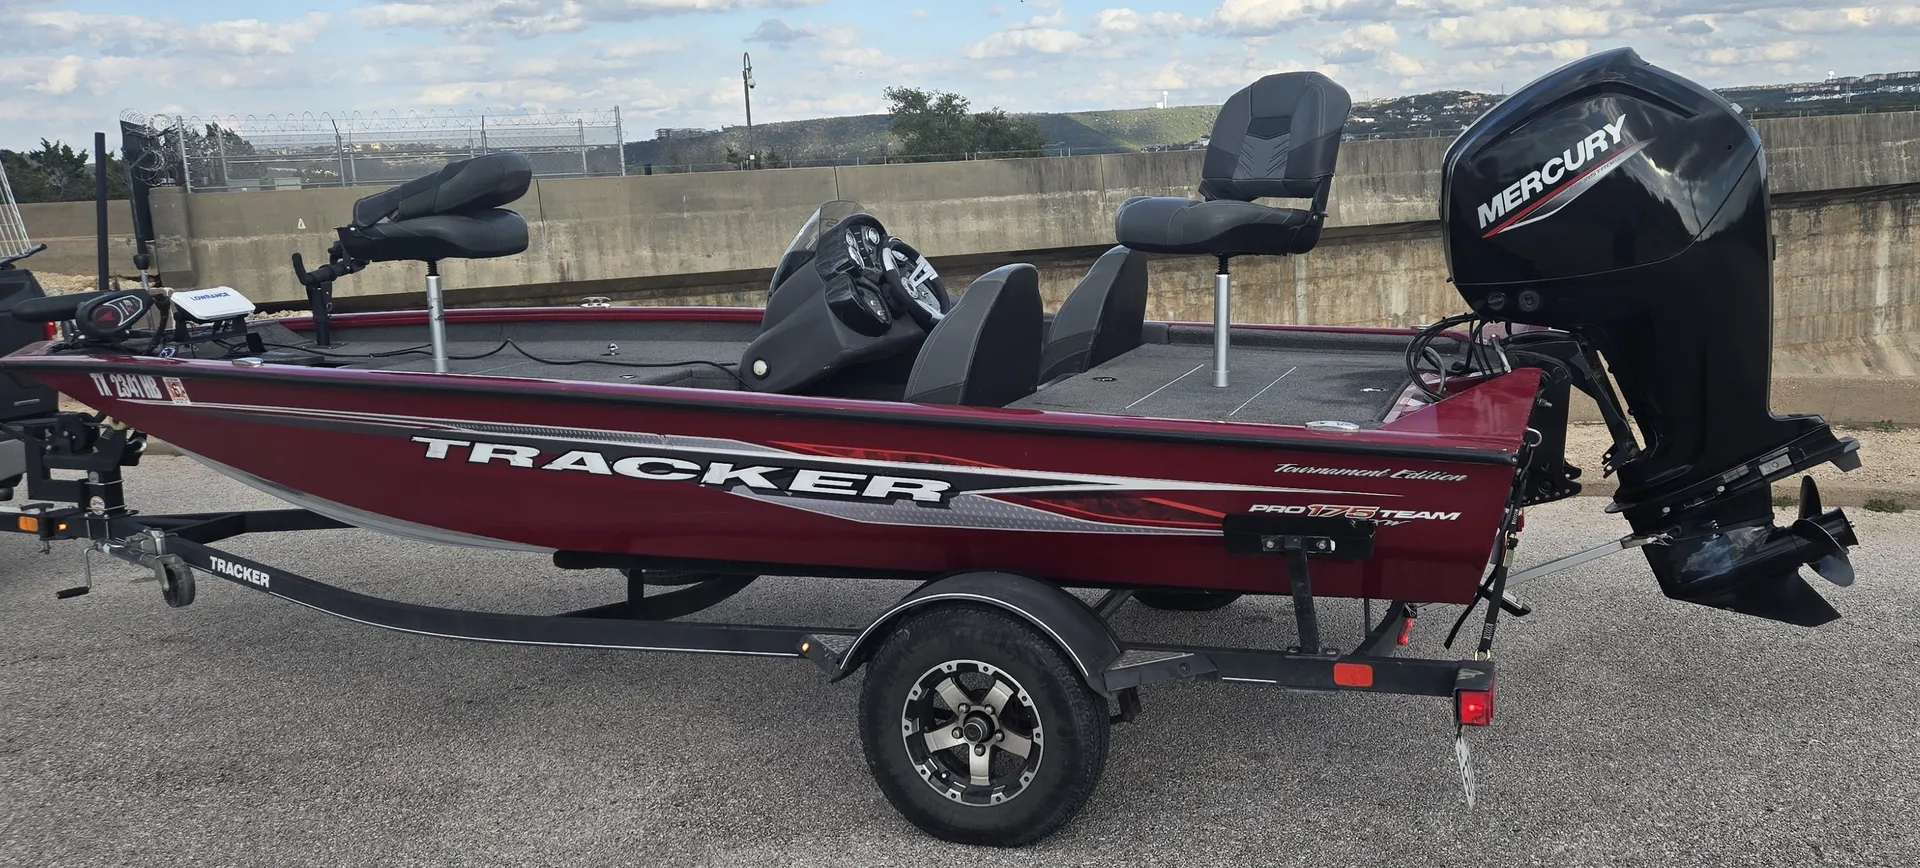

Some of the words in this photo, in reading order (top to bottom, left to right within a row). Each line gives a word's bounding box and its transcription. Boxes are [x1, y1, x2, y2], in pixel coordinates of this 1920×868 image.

[1477, 114, 1626, 229] MERCURY
[190, 292, 231, 301] LOWRANCE
[89, 373, 113, 396] TX
[110, 374, 145, 398] 2341
[138, 375, 163, 399] HB
[411, 436, 951, 502] TRACKER
[1274, 463, 1391, 478] Tournament
[1390, 469, 1468, 482] Edition
[1248, 504, 1306, 514] PRO
[1307, 503, 1381, 519] 175
[1379, 509, 1462, 521] TEAM
[209, 555, 270, 588] TRACKER
